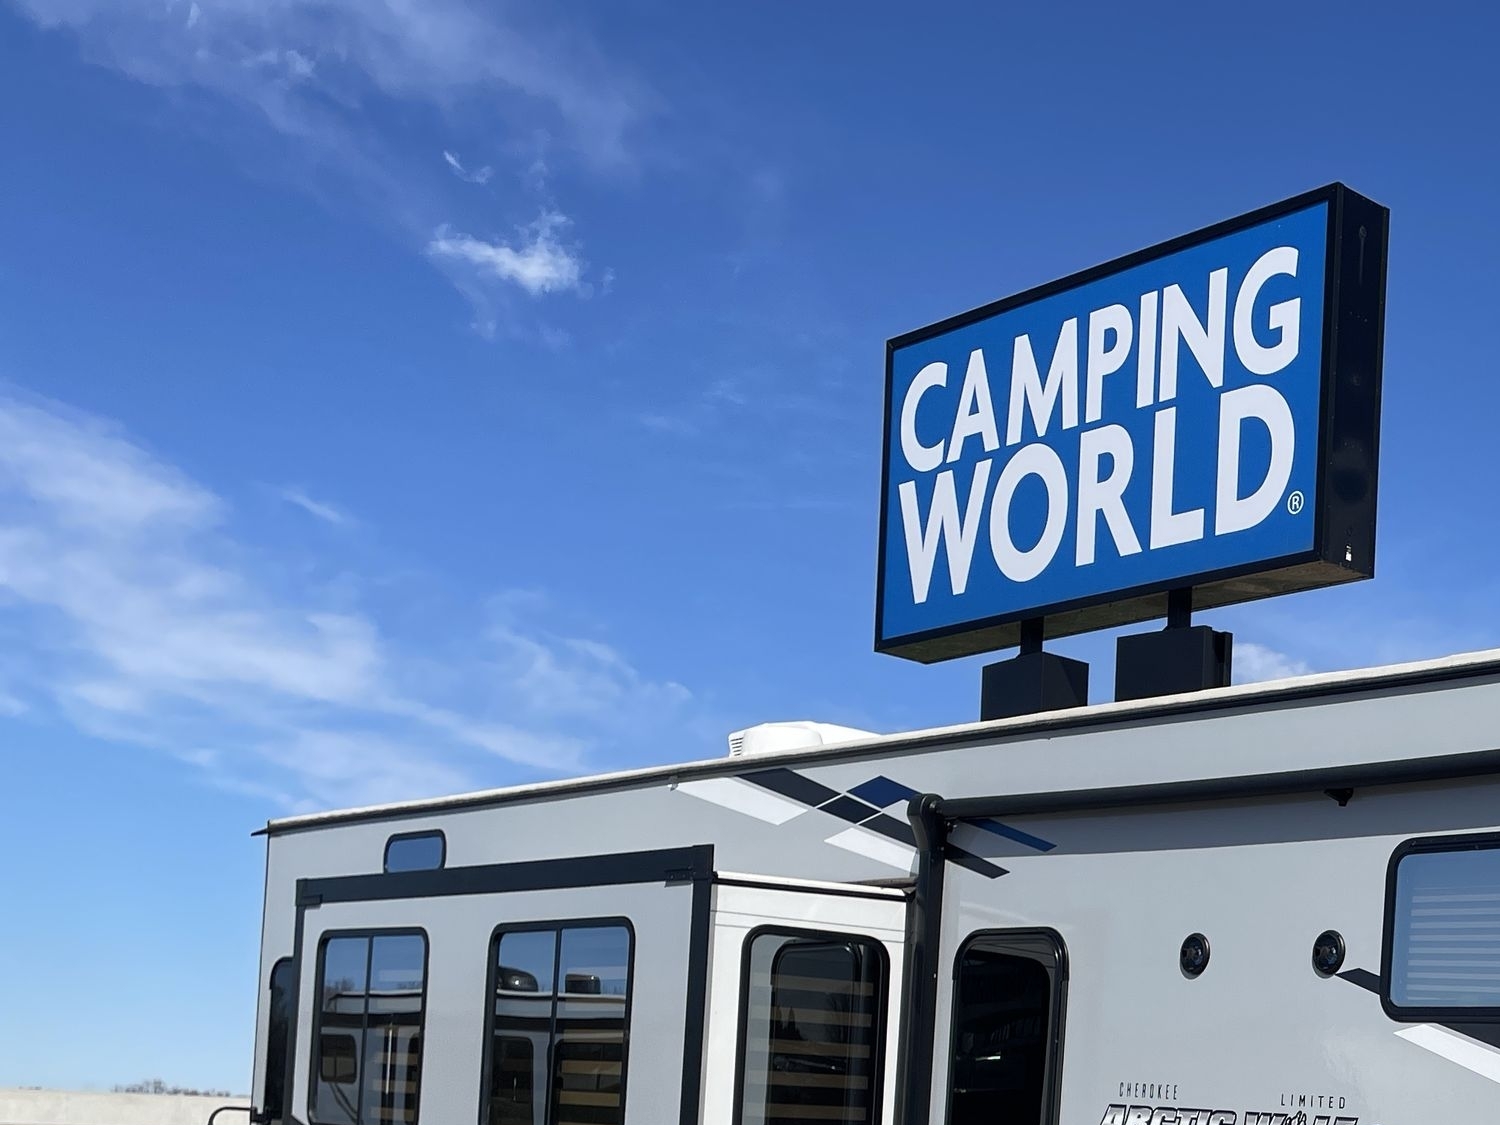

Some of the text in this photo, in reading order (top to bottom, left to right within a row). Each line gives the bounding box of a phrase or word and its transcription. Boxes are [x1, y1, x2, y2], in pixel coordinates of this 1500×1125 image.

[900, 246, 1301, 472] CAMPING
[1118, 1081, 1178, 1100] CHEROKEE
[1280, 1093, 1347, 1109] LIMITED
